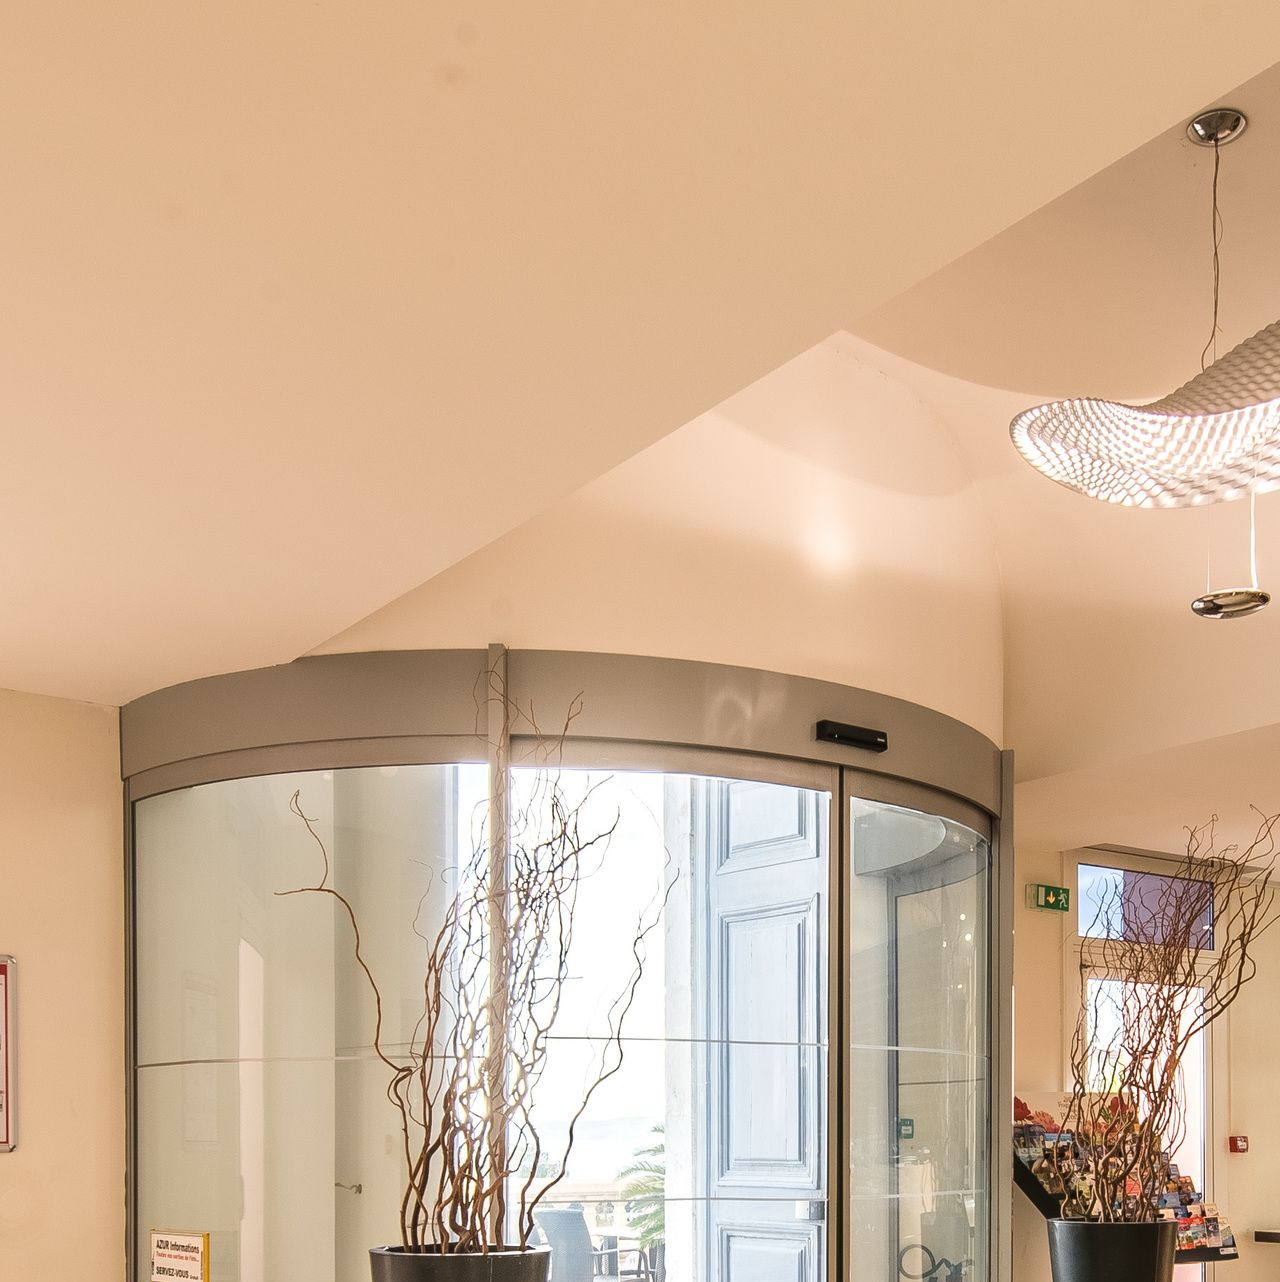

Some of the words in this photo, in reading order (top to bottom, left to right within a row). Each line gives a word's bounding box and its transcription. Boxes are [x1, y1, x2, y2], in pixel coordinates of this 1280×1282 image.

[156, 1239, 169, 1250] AZUR
[170, 1241, 200, 1254] Informations
[156, 1266, 189, 1279] SERVEZ-VOUS
